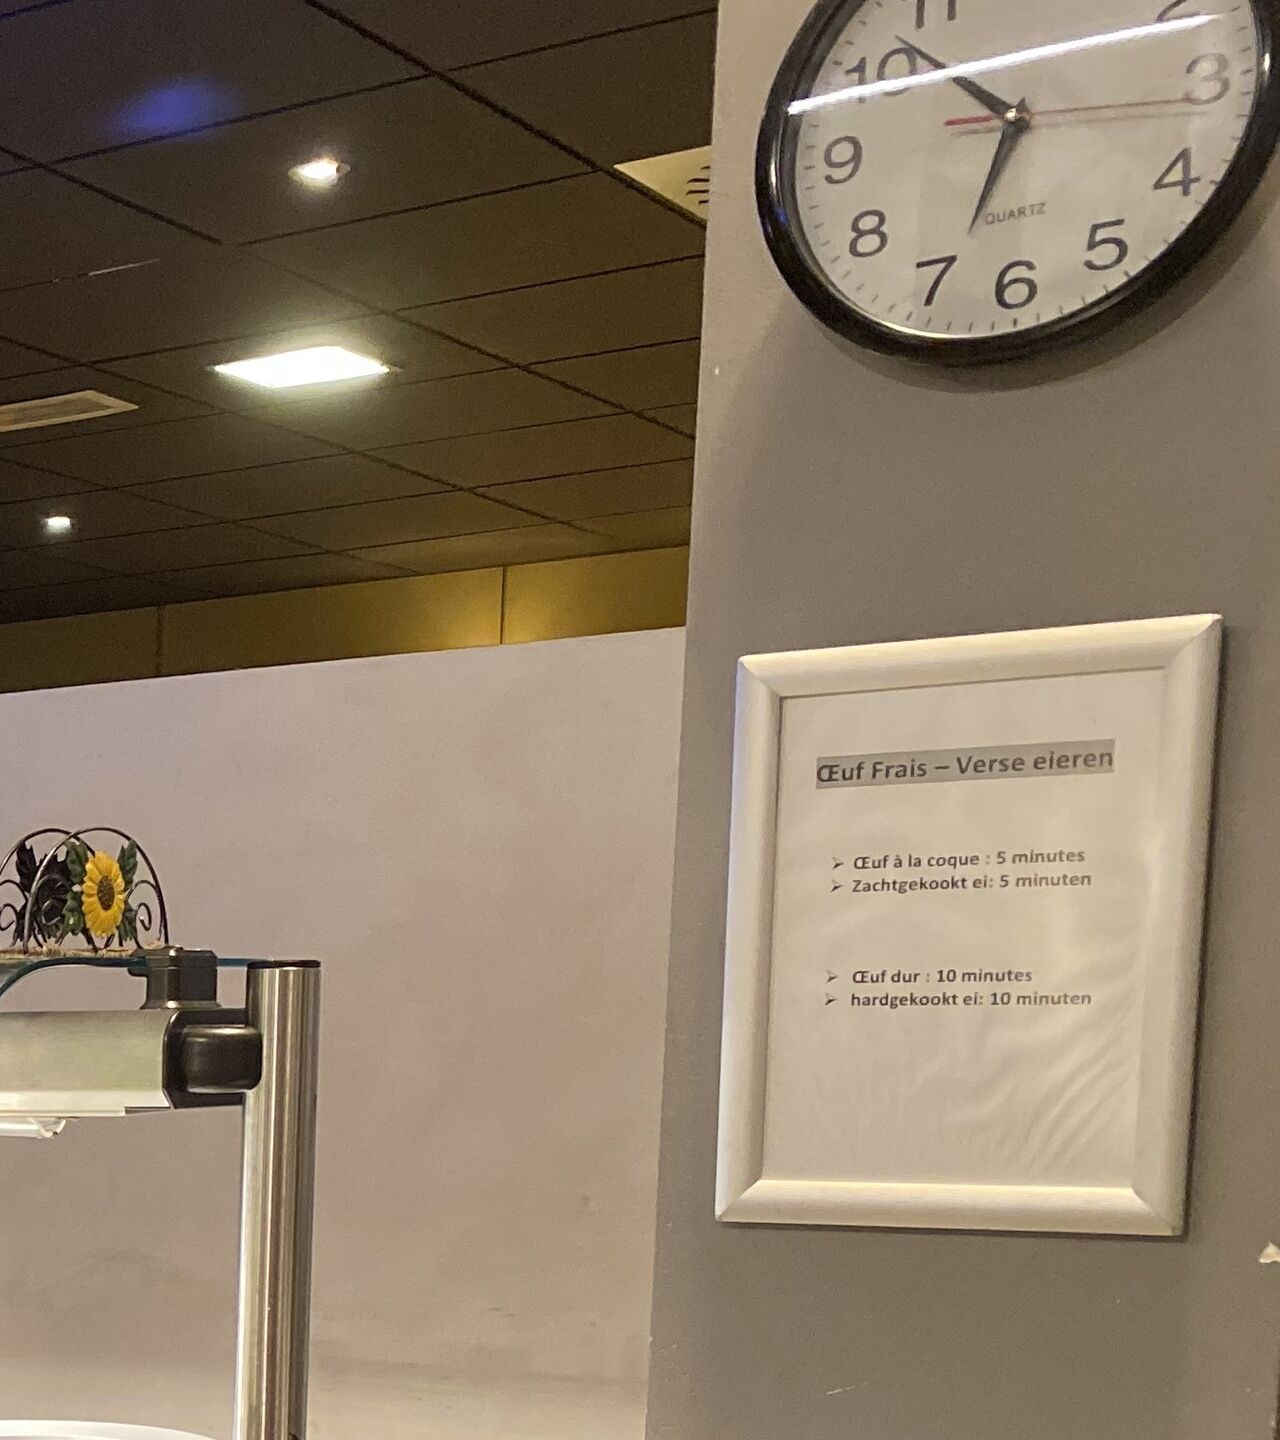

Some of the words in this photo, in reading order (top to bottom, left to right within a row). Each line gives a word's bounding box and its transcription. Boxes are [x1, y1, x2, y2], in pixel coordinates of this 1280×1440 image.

[1186, 53, 1231, 106] 3
[823, 136, 863, 184] 9
[1153, 147, 1200, 196] 4
[848, 210, 888, 258] 8
[984, 202, 1046, 225] QUARTZ
[1083, 219, 1129, 271] 5
[915, 255, 958, 307] 7
[995, 260, 1038, 309] 6
[817, 761, 865, 782] Œuf
[872, 758, 927, 779] Frais
[956, 755, 1025, 774] Verse
[1033, 751, 1113, 770] eieren
[852, 876, 968, 894] Zachtgekookt
[973, 875, 994, 889] ei:
[1000, 875, 1009, 888] 5
[1016, 873, 1091, 887] minuten
[853, 855, 889, 870] Œuf
[908, 854, 921, 868] la
[927, 854, 980, 870] coque
[996, 851, 1006, 864] 5
[1012, 849, 1085, 864] minutes
[852, 970, 887, 983] Œuf
[891, 969, 920, 983] dur
[937, 969, 956, 983] 10
[962, 968, 1032, 982] minutes
[851, 992, 958, 1009] hardgekookt
[963, 992, 984, 1006] ei:
[990, 992, 1011, 1006] 10
[1016, 992, 1091, 1006] minuten
